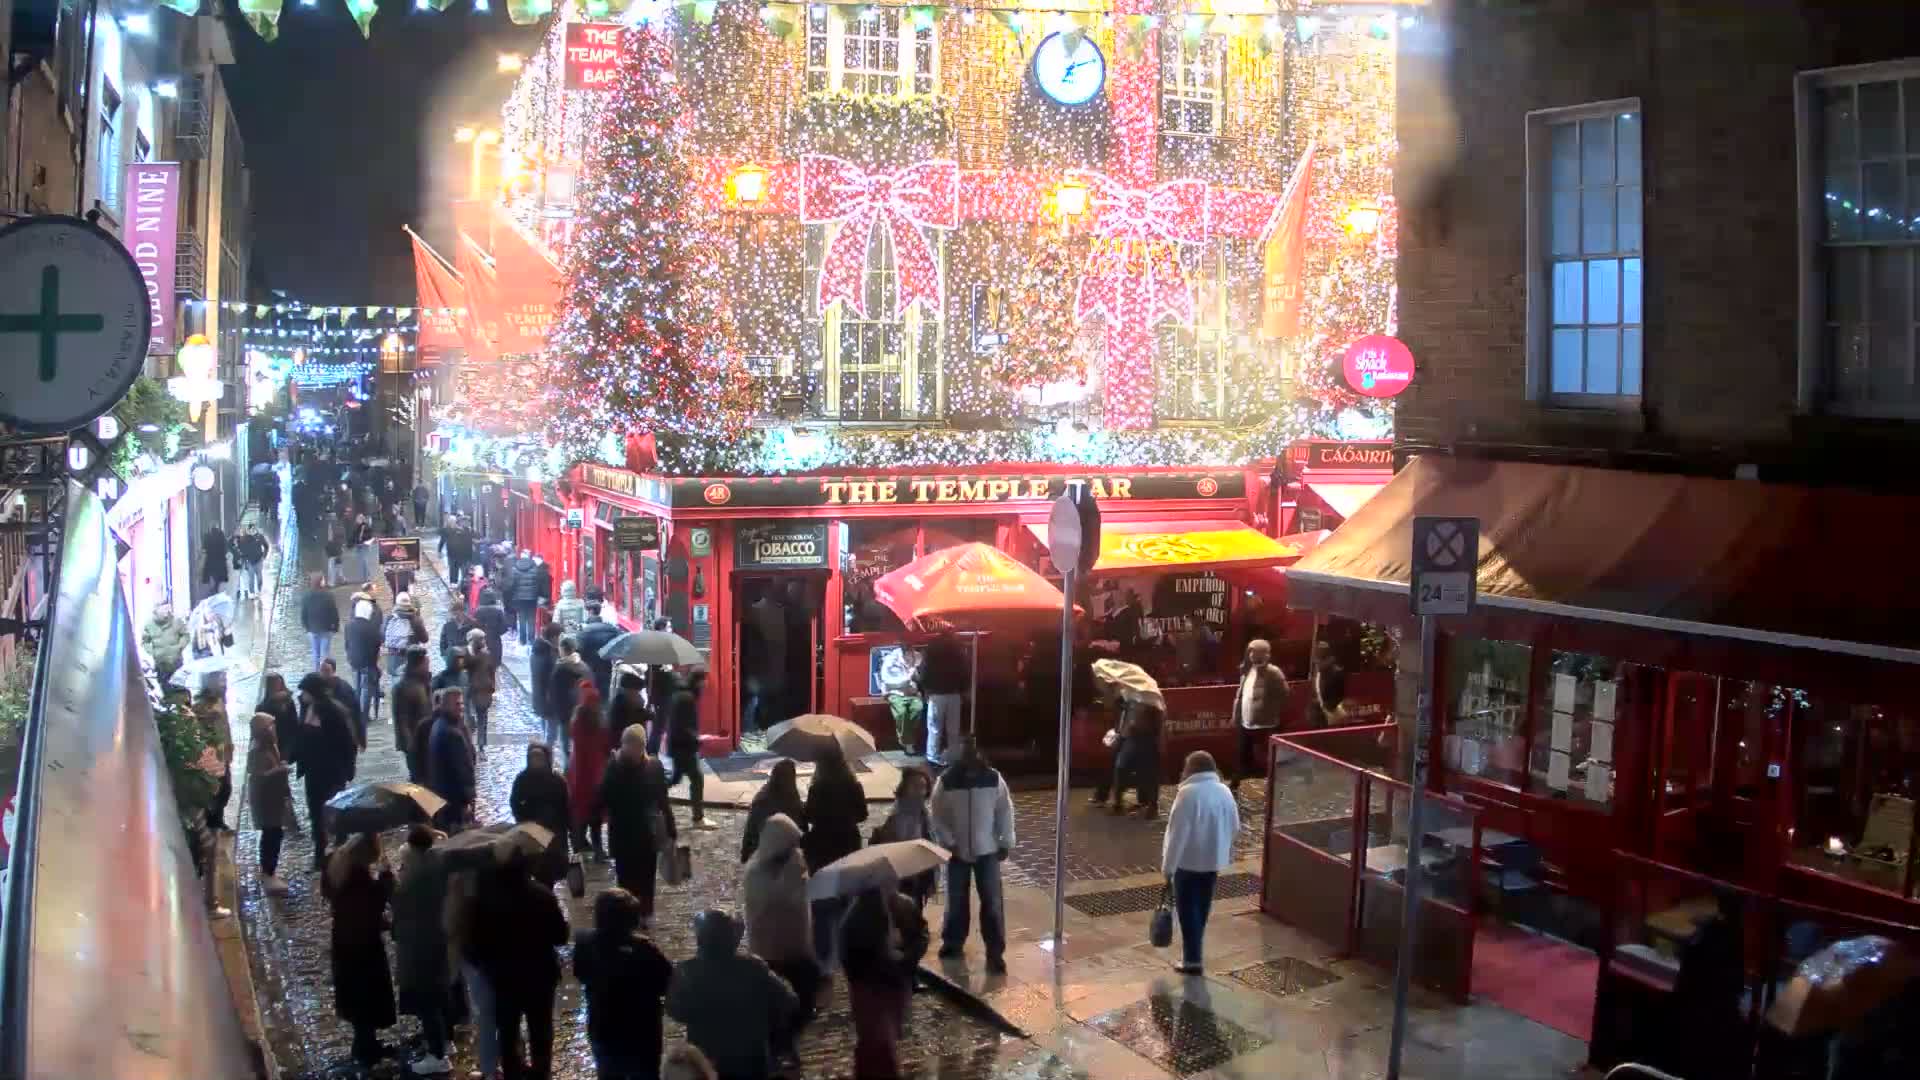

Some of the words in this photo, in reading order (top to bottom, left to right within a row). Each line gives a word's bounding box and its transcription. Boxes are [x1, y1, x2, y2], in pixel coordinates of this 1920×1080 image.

[584, 29, 617, 45] THE
[568, 48, 622, 64] TEMPL
[136, 172, 168, 232] NINE
[823, 482, 898, 503] THE
[911, 480, 1049, 502] TEMPLE
[752, 539, 816, 561] TOBACCO
[1211, 593, 1224, 607] OF
[1423, 585, 1442, 602] 24
